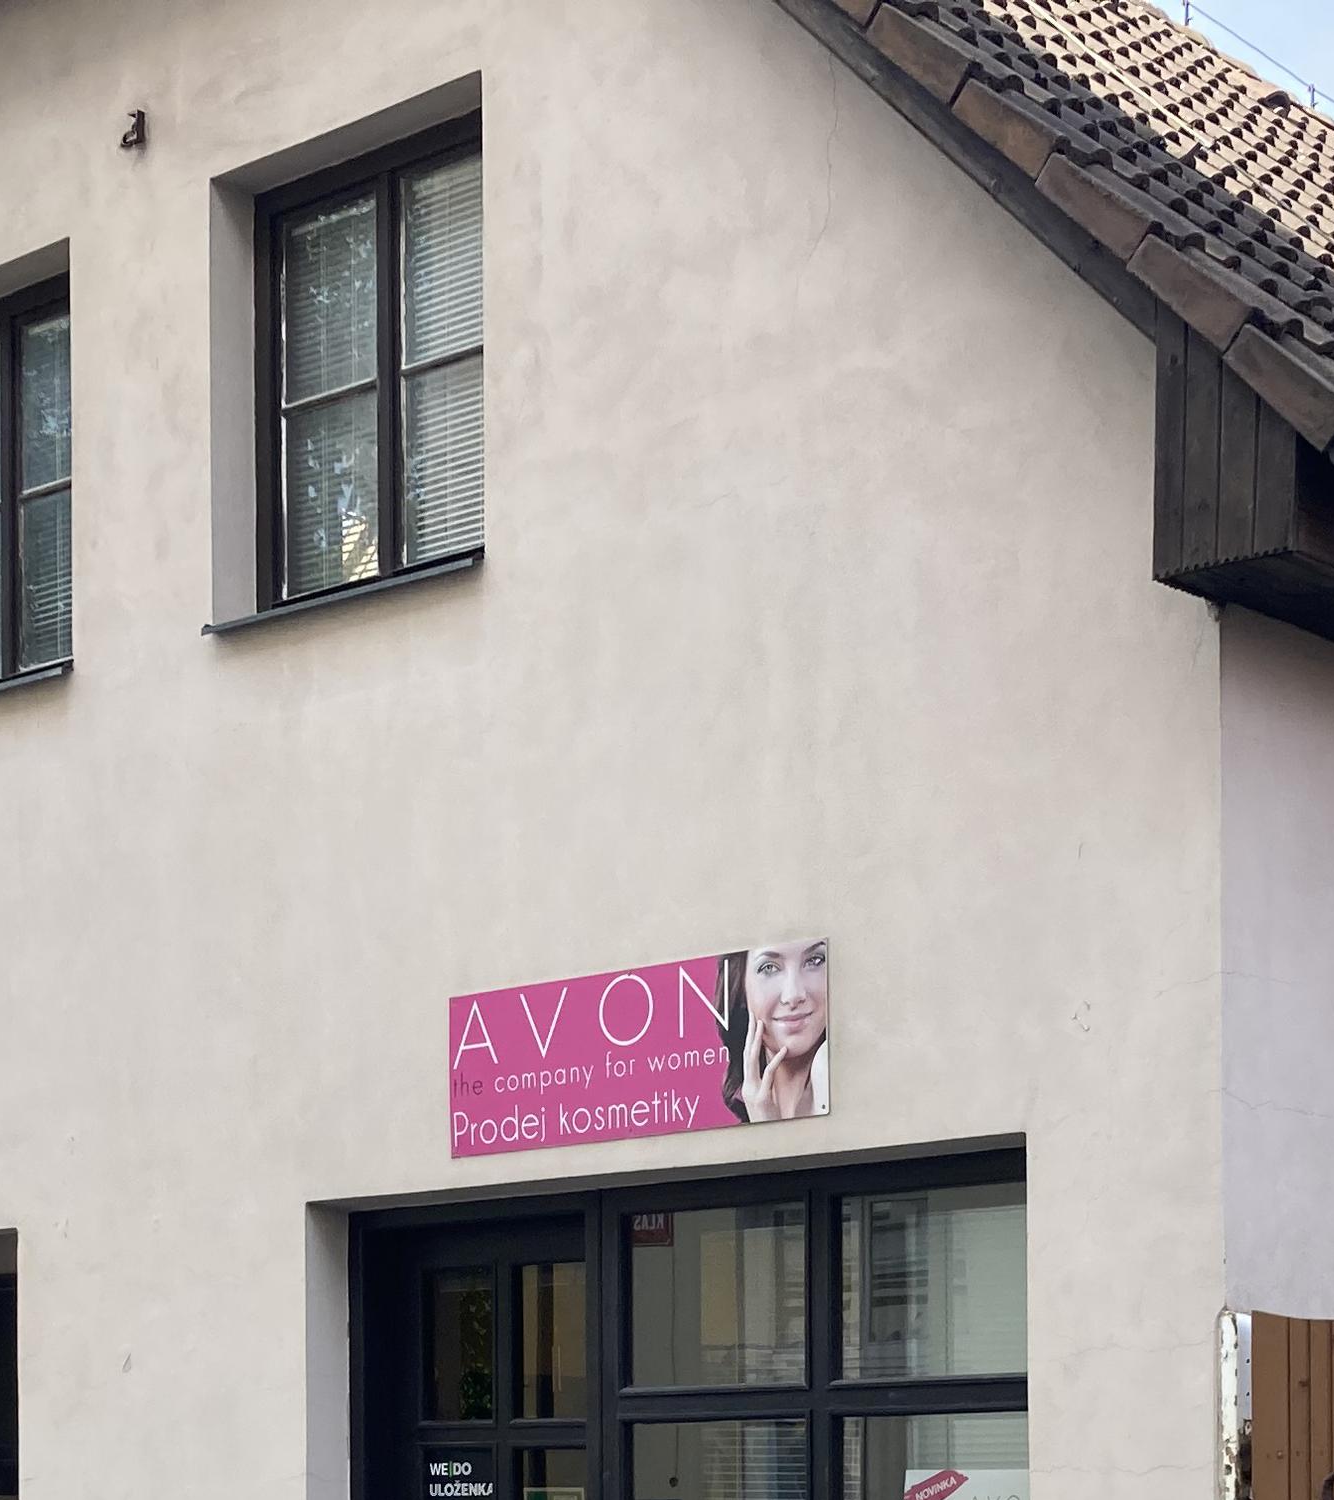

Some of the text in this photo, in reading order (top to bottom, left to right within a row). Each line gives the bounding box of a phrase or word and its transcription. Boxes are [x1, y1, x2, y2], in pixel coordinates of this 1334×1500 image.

[453, 959, 730, 1070] AVON
[494, 1064, 594, 1095] company
[606, 1050, 634, 1078] for
[647, 1045, 730, 1073] women
[453, 1090, 700, 1148] Prodej kosmetiky
